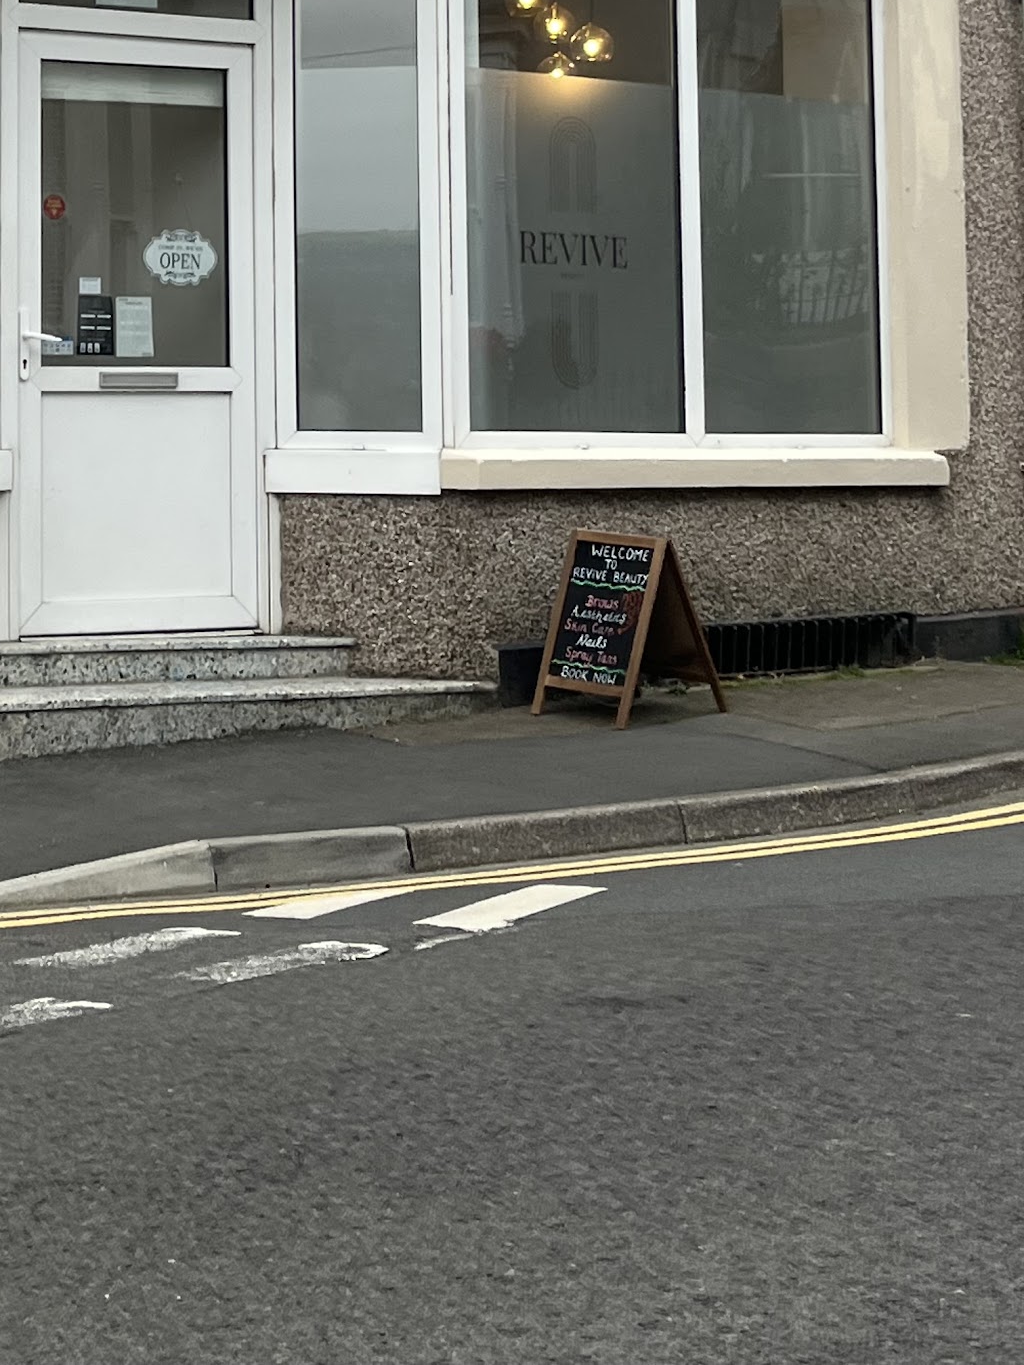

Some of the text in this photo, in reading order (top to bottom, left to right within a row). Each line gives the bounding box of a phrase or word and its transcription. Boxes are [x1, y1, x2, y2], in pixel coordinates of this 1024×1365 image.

[520, 230, 628, 269] REVIVE
[159, 252, 201, 269] OPEN
[591, 544, 650, 562] WELCOME
[604, 558, 618, 570] TO
[573, 566, 649, 585] REVIVE BEAUTY
[584, 595, 619, 609] Brows
[564, 618, 614, 635] Skin Care
[576, 633, 607, 649] Nails
[565, 646, 617, 668] Spray Tans
[560, 665, 616, 685] BOOK NOW
